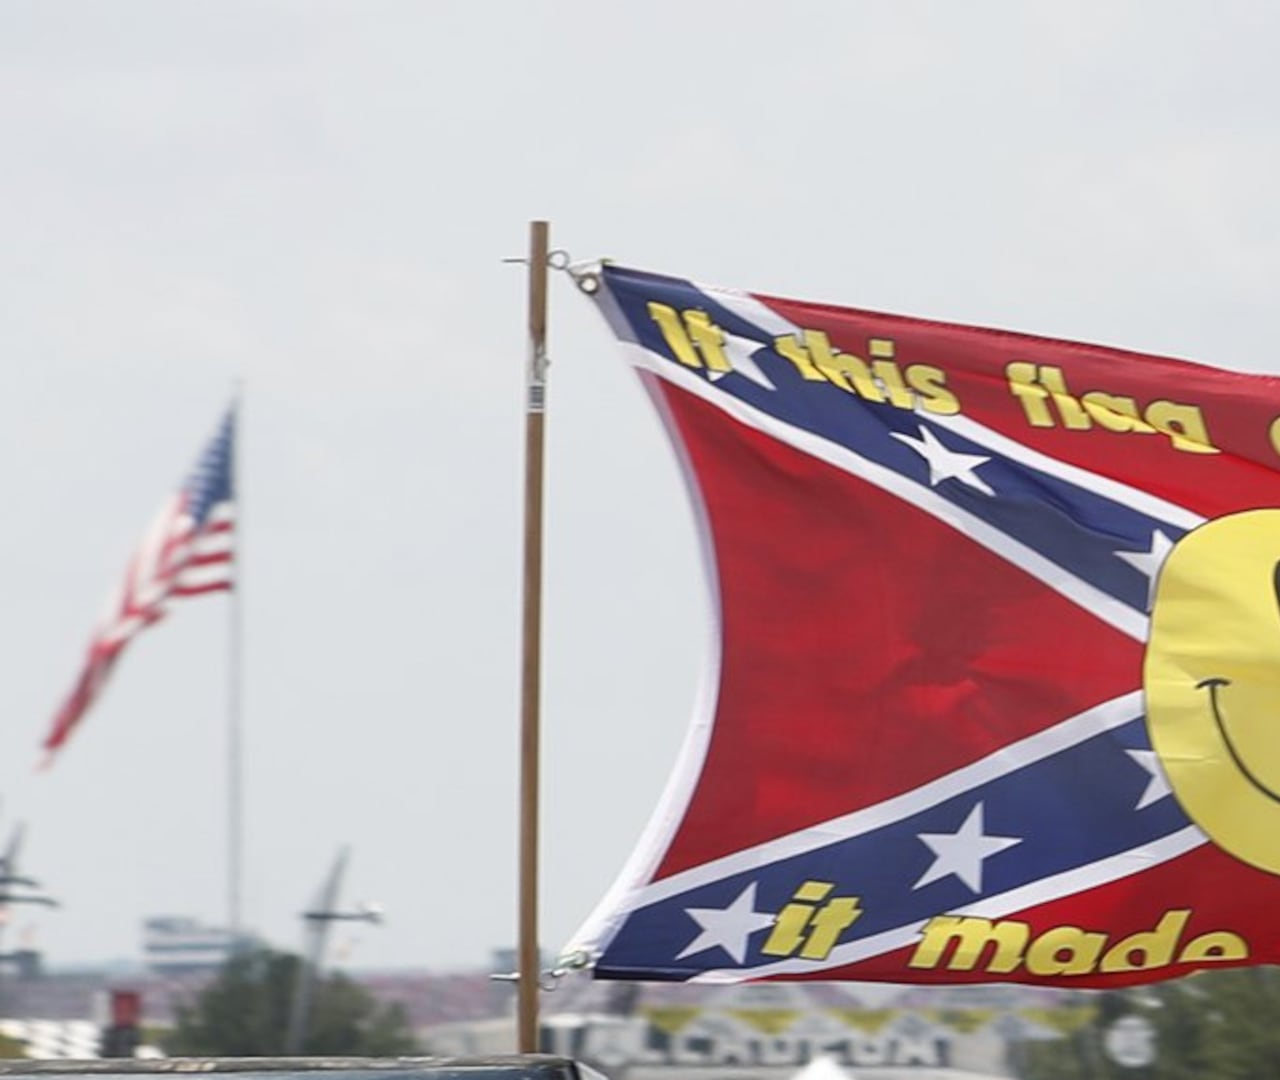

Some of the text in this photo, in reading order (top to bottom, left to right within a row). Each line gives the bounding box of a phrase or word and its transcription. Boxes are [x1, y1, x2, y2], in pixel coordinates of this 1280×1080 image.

[646, 301, 735, 374] If
[773, 328, 961, 415] this
[1004, 361, 1221, 454] flag
[760, 880, 863, 960] it
